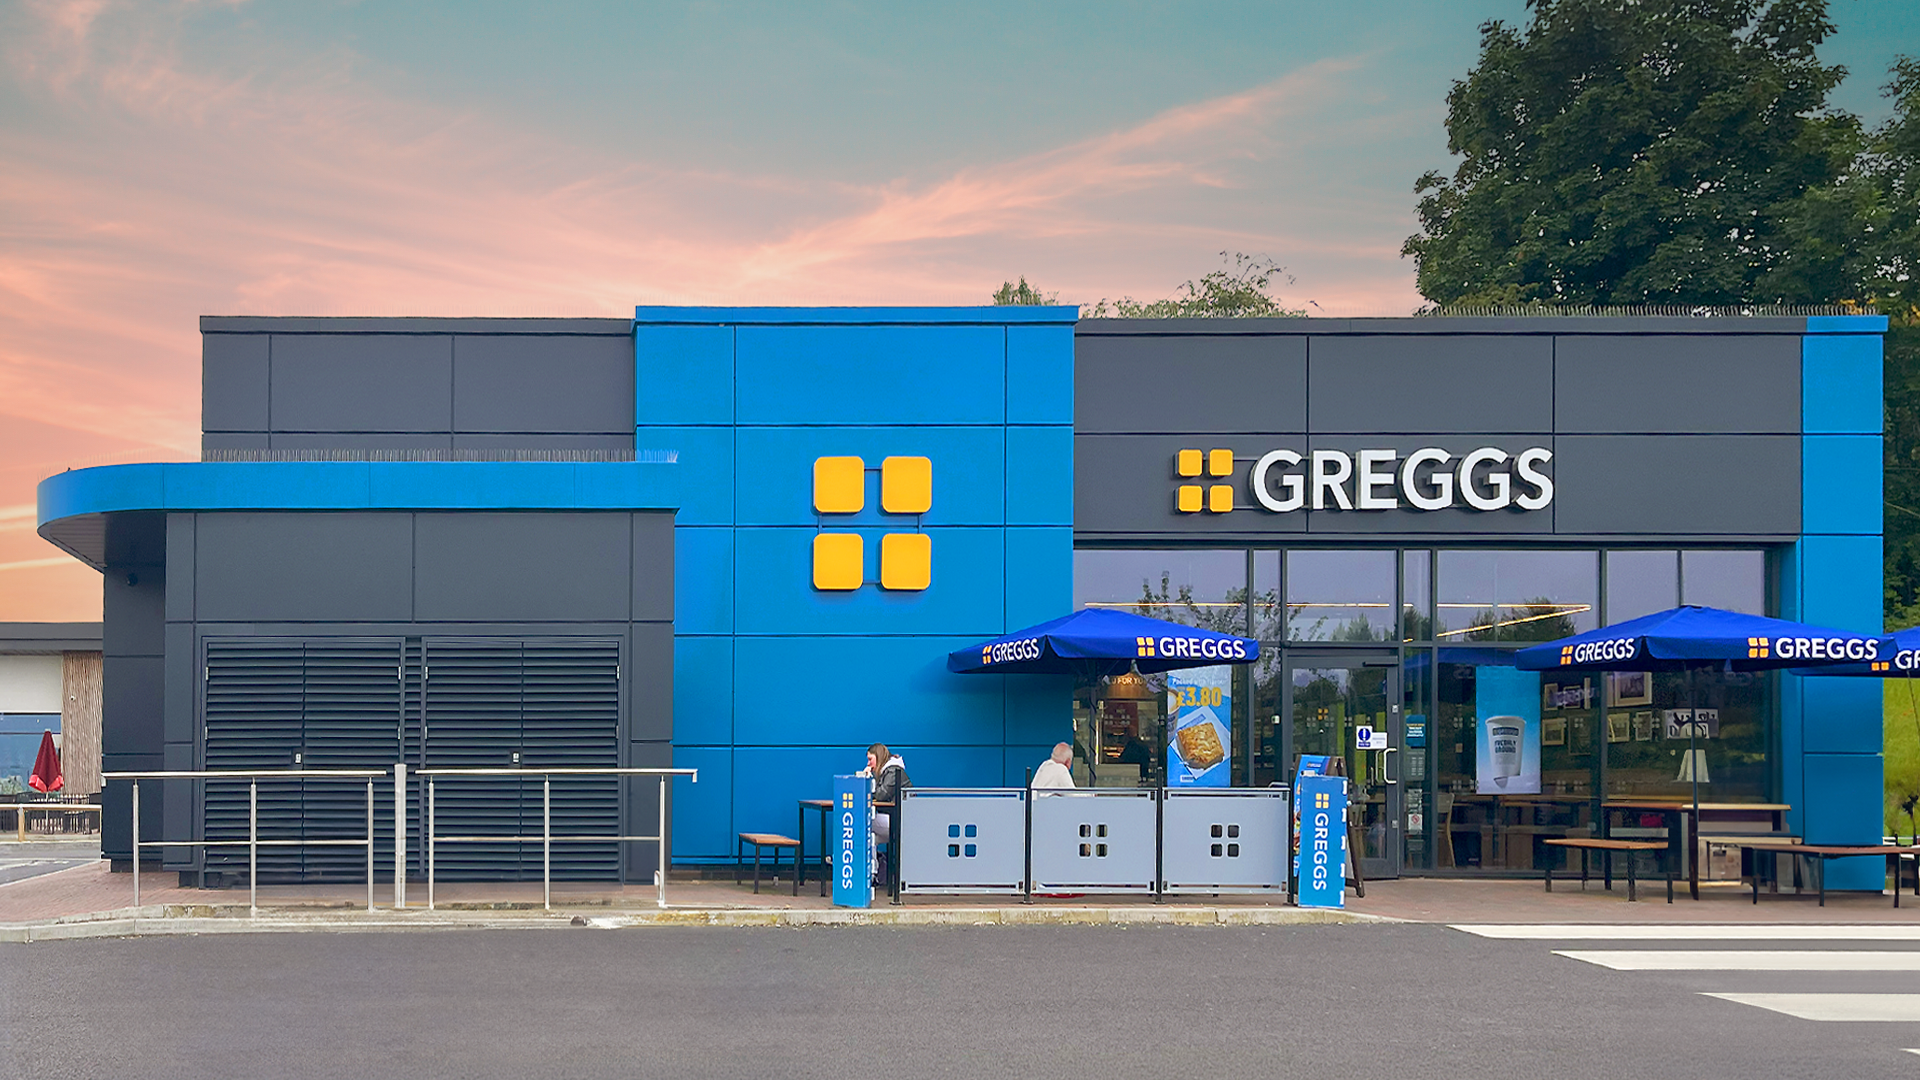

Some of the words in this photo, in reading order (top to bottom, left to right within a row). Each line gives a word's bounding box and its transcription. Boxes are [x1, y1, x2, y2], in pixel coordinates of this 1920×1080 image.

[1252, 447, 1553, 512] GREGGS
[992, 638, 1040, 663] GREGGS
[1159, 637, 1246, 659] GREGGS
[1574, 638, 1635, 663] GREGGS
[1775, 637, 1879, 660] GREGGS
[1117, 677, 1132, 685] FOR
[1176, 687, 1222, 707] £3.80
[842, 812, 854, 889] GREGGS
[1312, 813, 1329, 891] GREGGS
